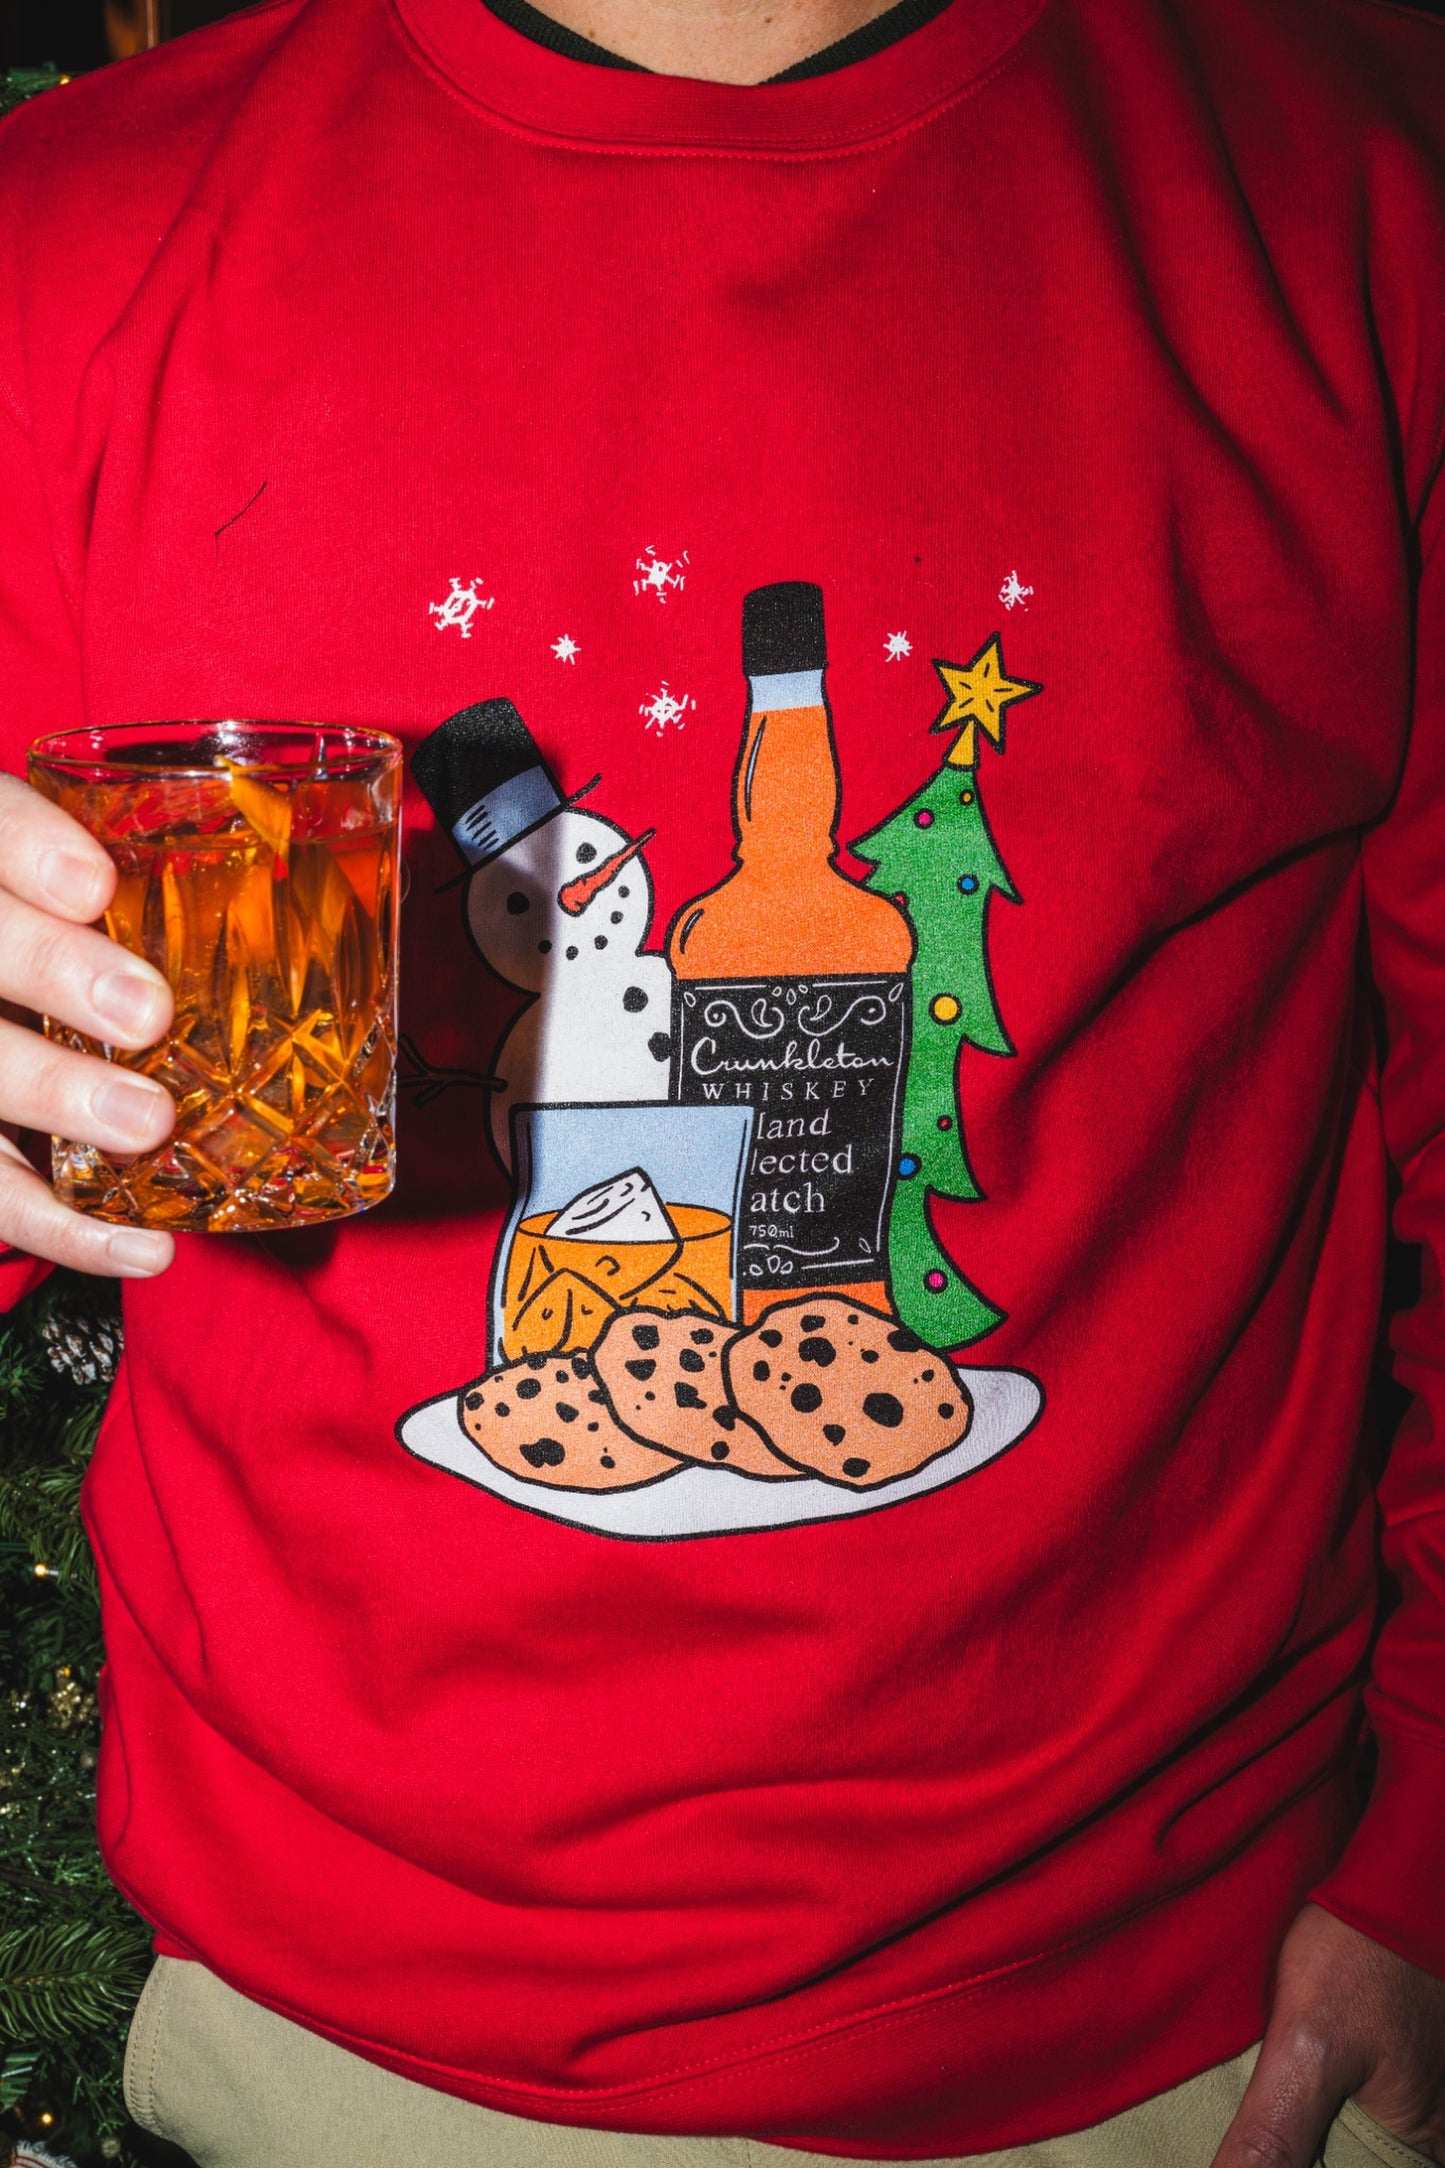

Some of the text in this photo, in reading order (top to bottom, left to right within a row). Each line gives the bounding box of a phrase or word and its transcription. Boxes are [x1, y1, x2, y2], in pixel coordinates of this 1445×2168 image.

[691, 1036, 895, 1075] Crunkleton
[702, 1078, 875, 1101] WHISKEY
[750, 1181, 825, 1213] atch
